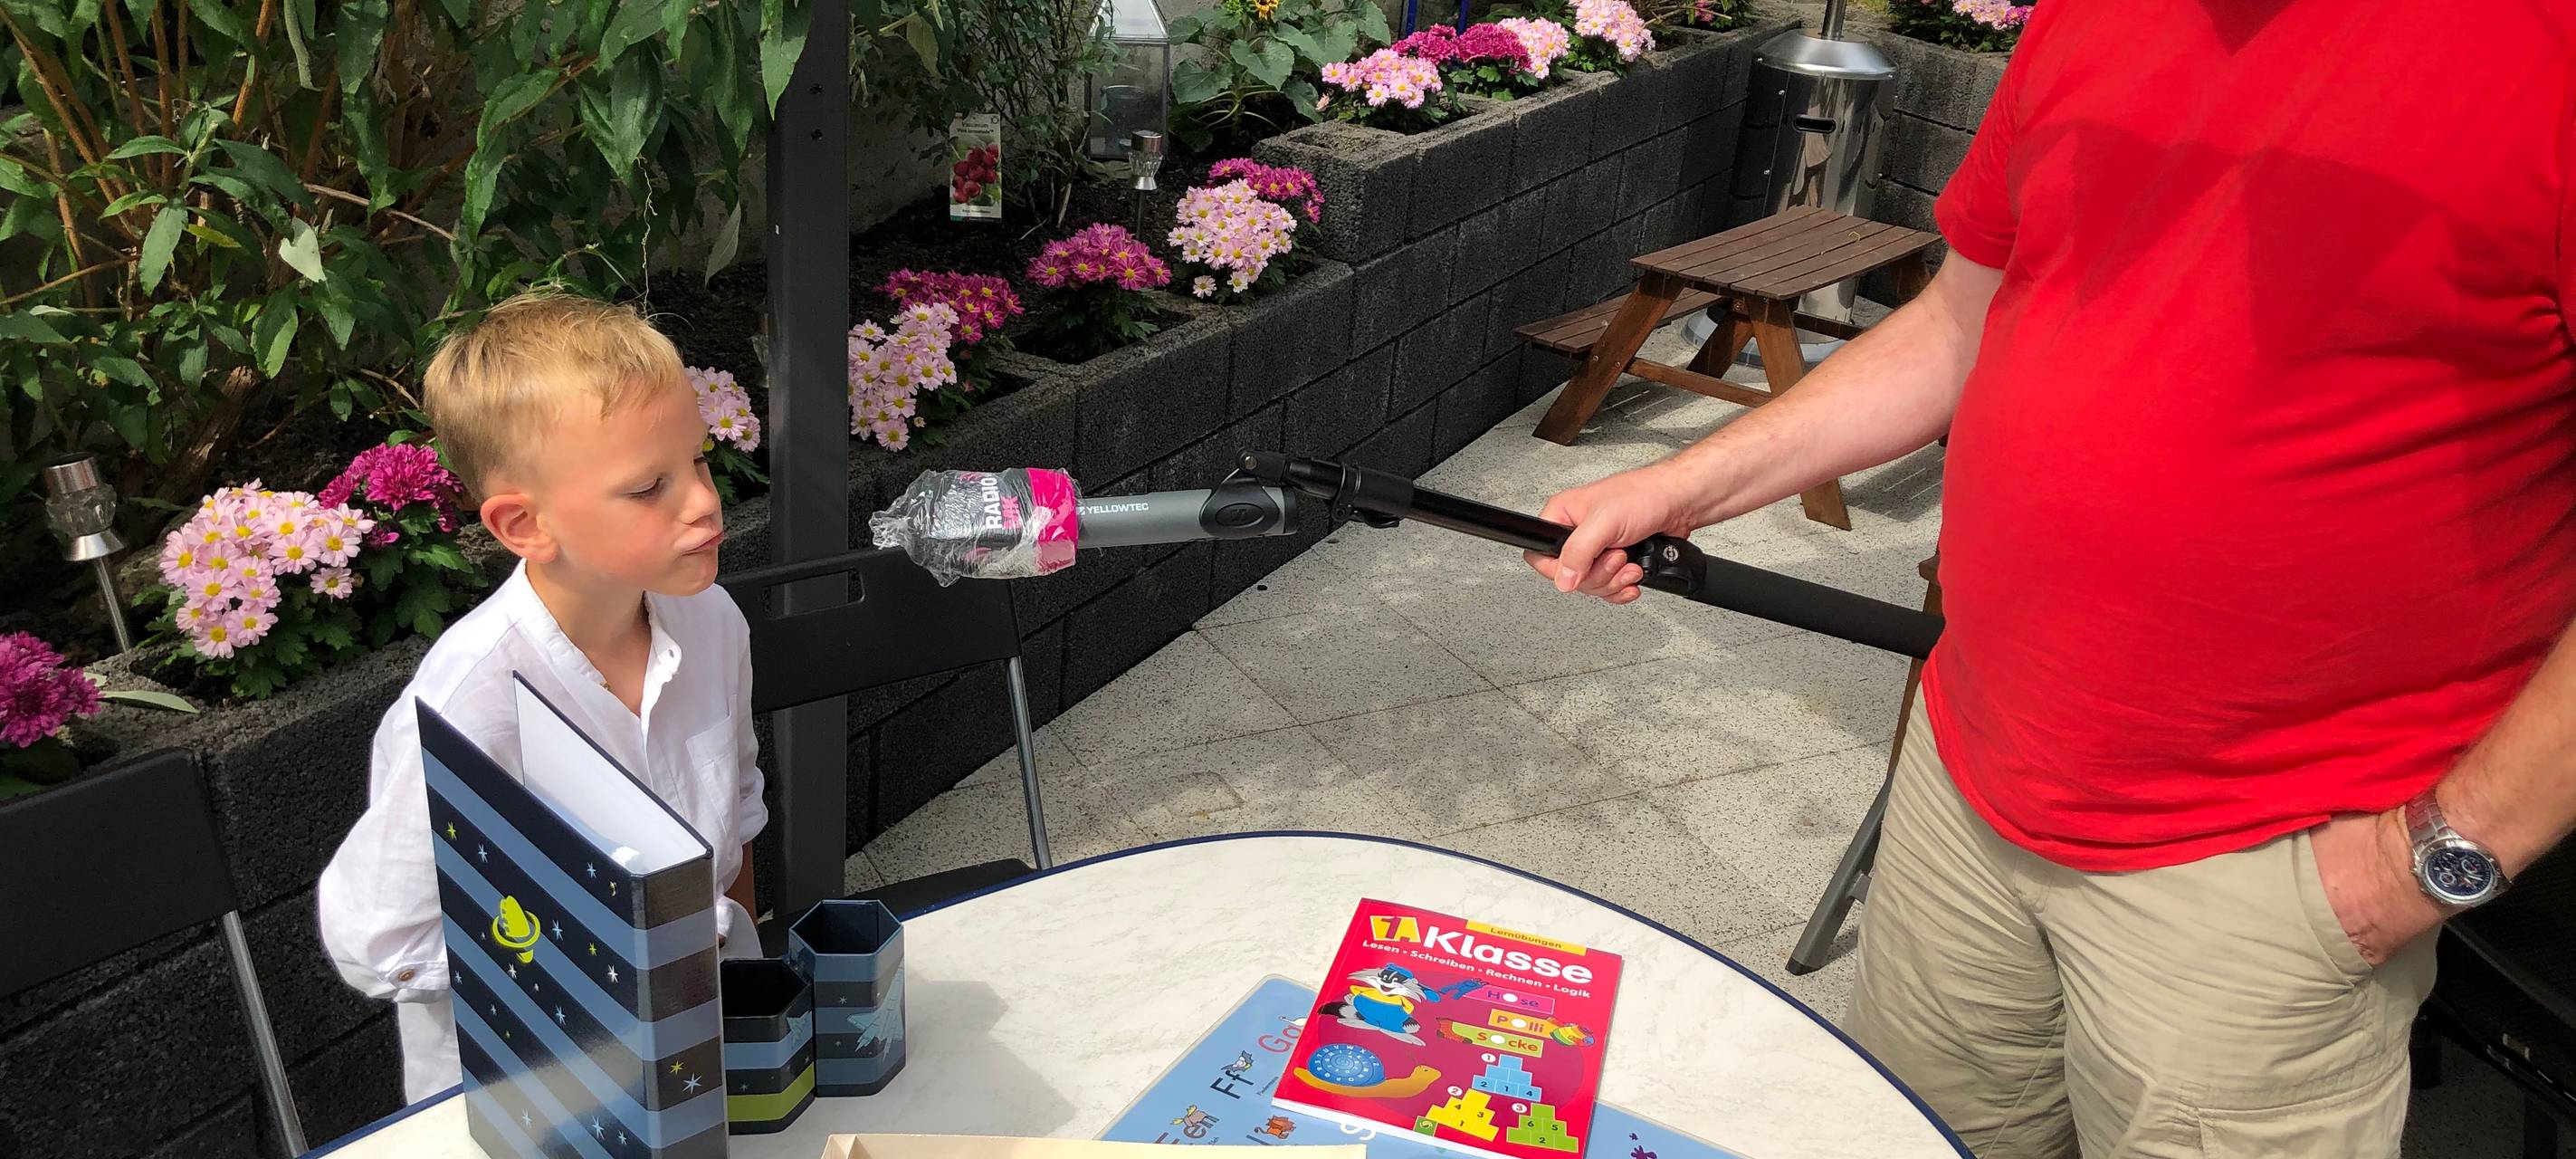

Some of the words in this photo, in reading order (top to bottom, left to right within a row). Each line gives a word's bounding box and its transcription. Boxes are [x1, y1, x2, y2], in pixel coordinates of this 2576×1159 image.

[982, 477, 1002, 529] RADIO
[1086, 503, 1149, 513] YELLOWTEC
[1423, 926, 1593, 984] Klasse
[1490, 927, 1562, 949] Lernübungen
[1362, 940, 1399, 953] Lesen
[1410, 950, 1475, 972] Schreiben
[1485, 968, 1542, 988] Rechnen
[1553, 982, 1591, 999] Logik
